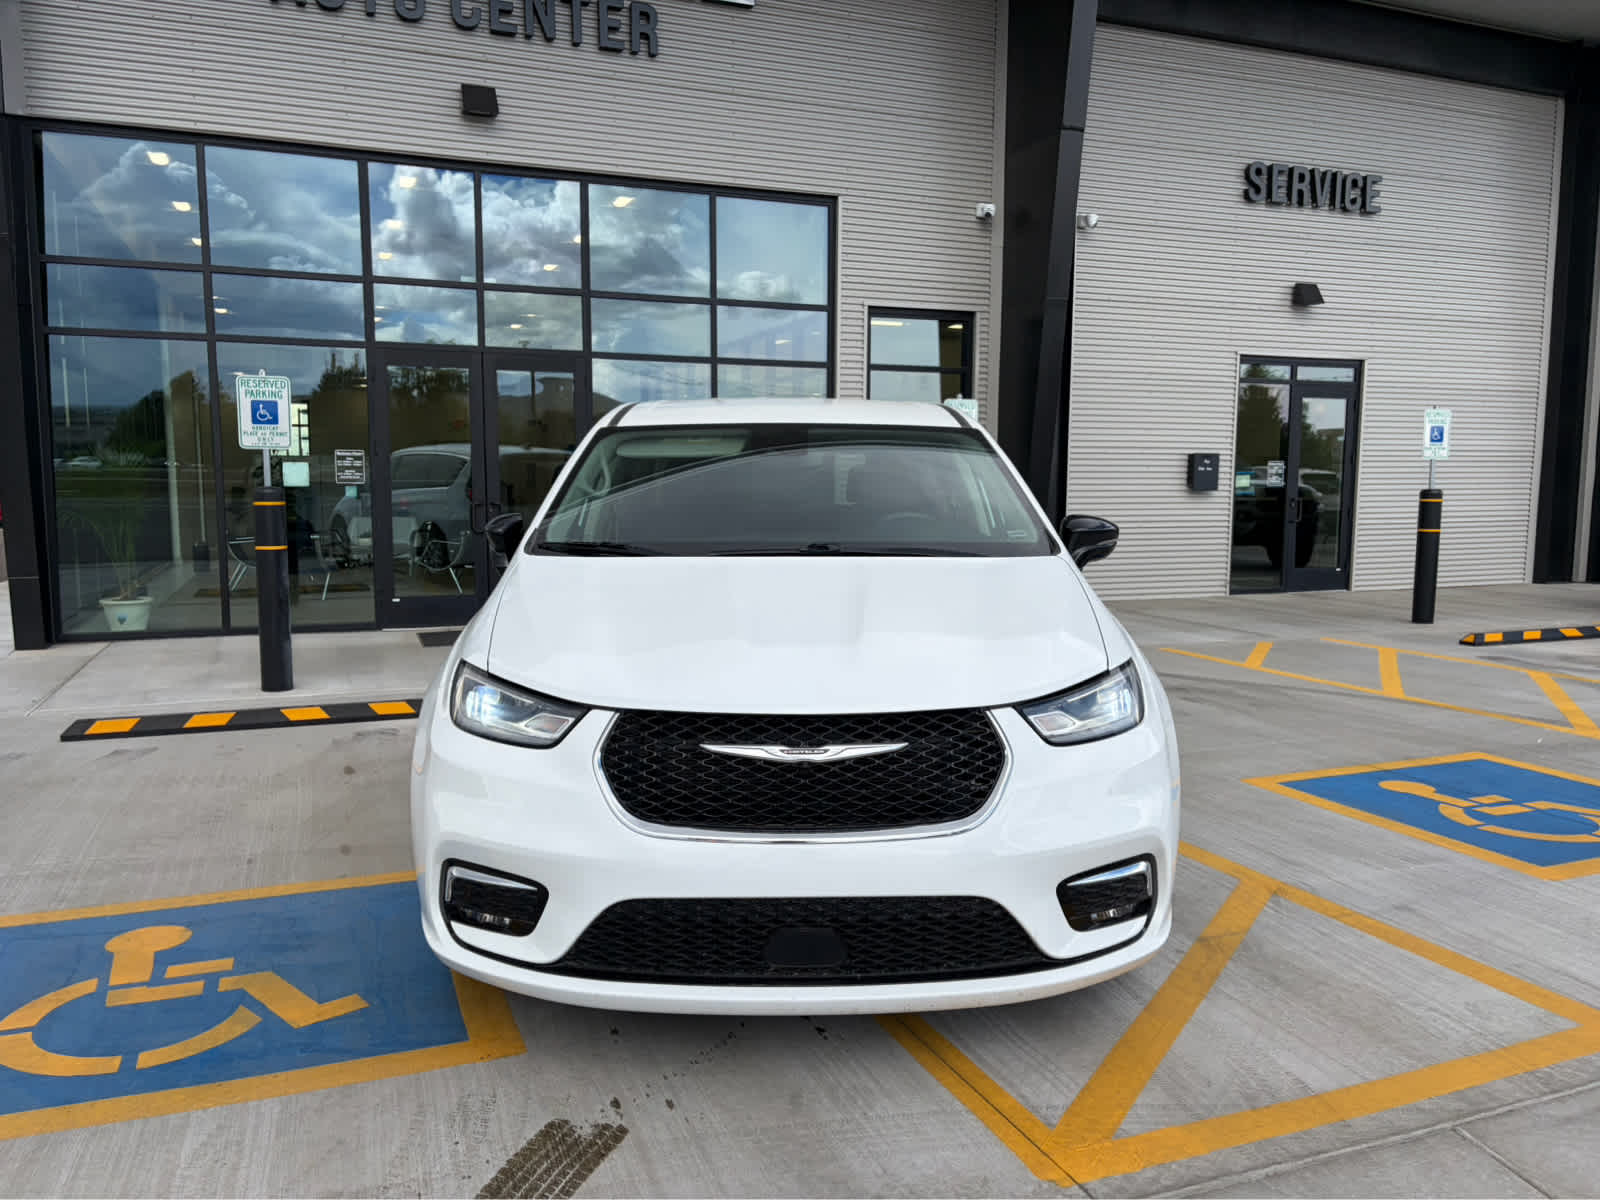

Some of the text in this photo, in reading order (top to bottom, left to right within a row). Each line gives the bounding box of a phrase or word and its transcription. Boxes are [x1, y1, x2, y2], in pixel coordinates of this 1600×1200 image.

[1243, 161, 1383, 214] SERVICE
[240, 379, 287, 389] RESERVED
[245, 389, 283, 400] PARKING
